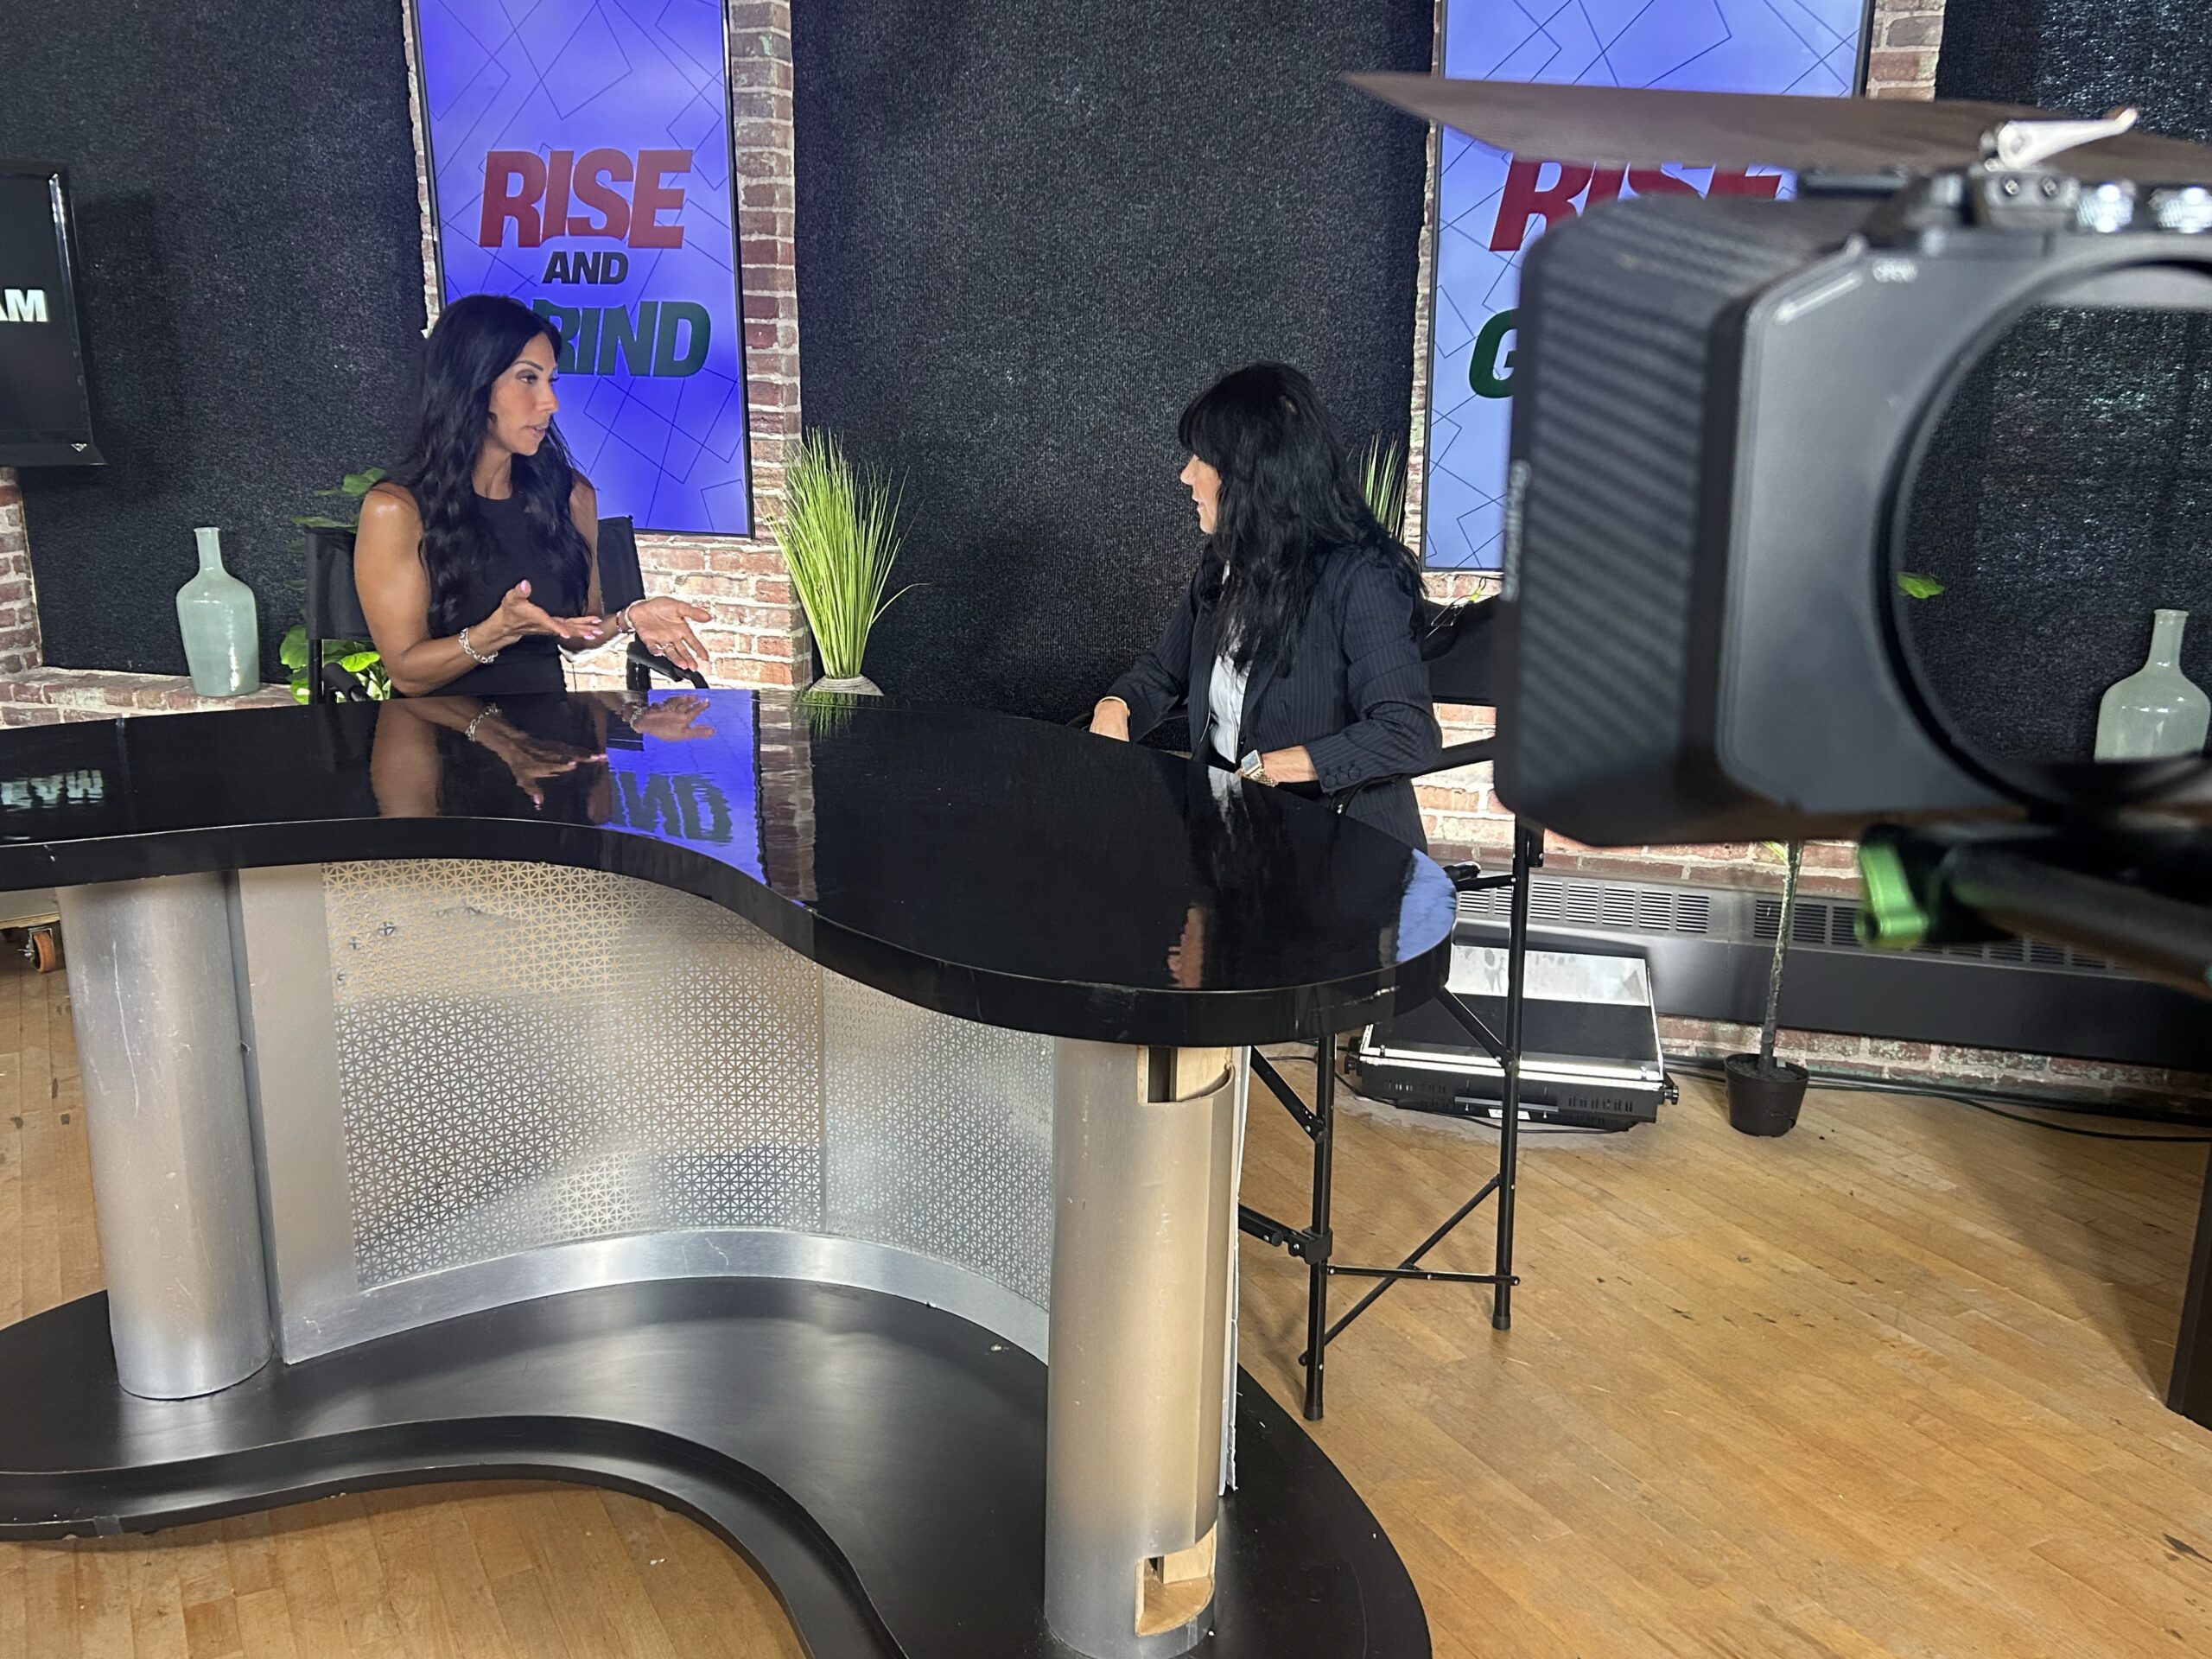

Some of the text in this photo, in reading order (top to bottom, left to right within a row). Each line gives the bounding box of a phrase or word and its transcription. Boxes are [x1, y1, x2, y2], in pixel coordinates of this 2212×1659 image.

[479, 148, 693, 250] RISE
[542, 251, 629, 285] AND
[532, 299, 712, 378] RIND
